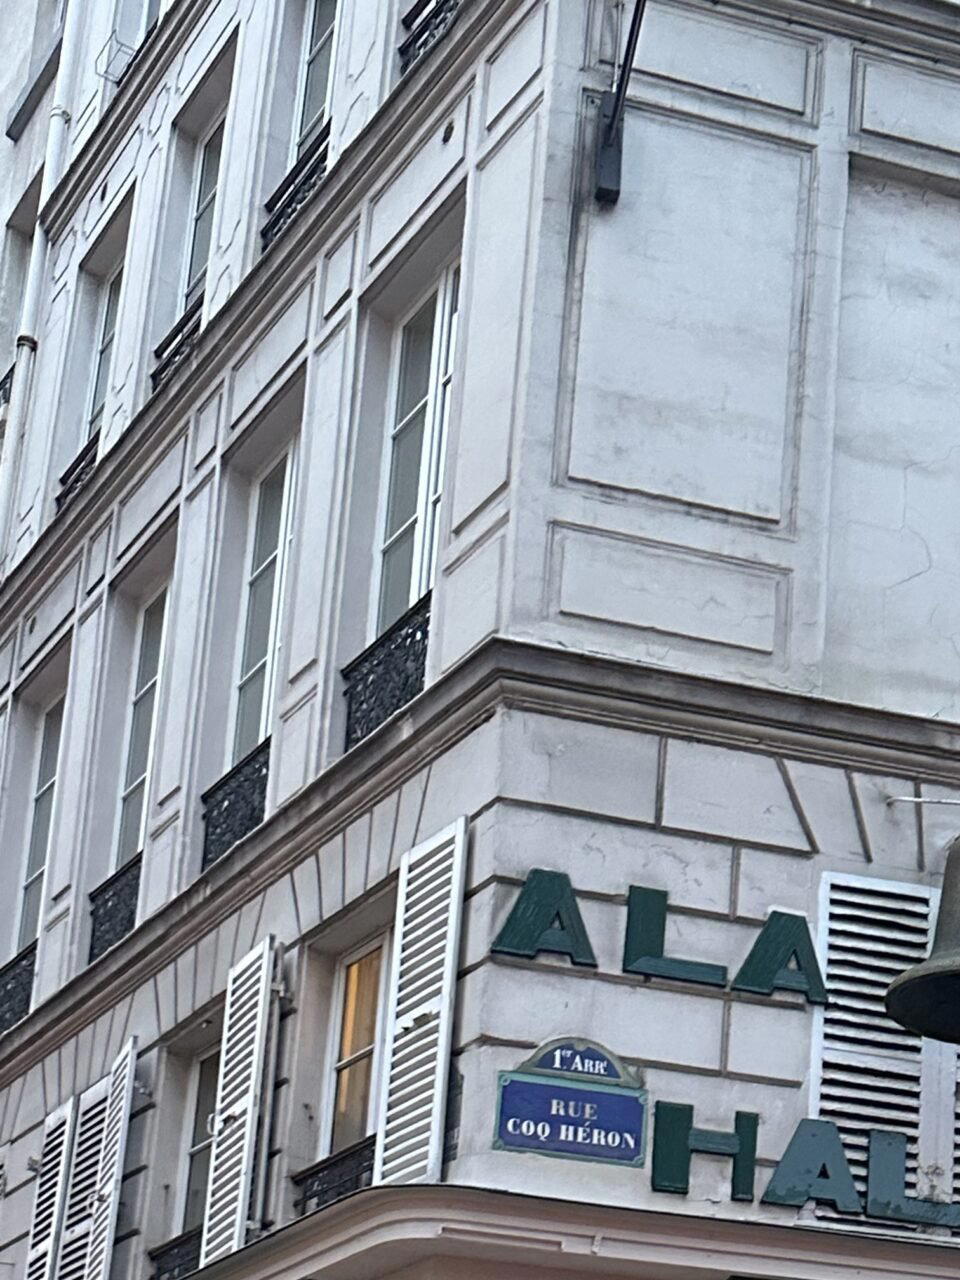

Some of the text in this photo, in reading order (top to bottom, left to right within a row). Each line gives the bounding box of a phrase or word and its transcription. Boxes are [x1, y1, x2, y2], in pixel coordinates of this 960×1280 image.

[550, 1099, 598, 1120] RUE
[506, 1117, 637, 1150] COQ HÉRON
